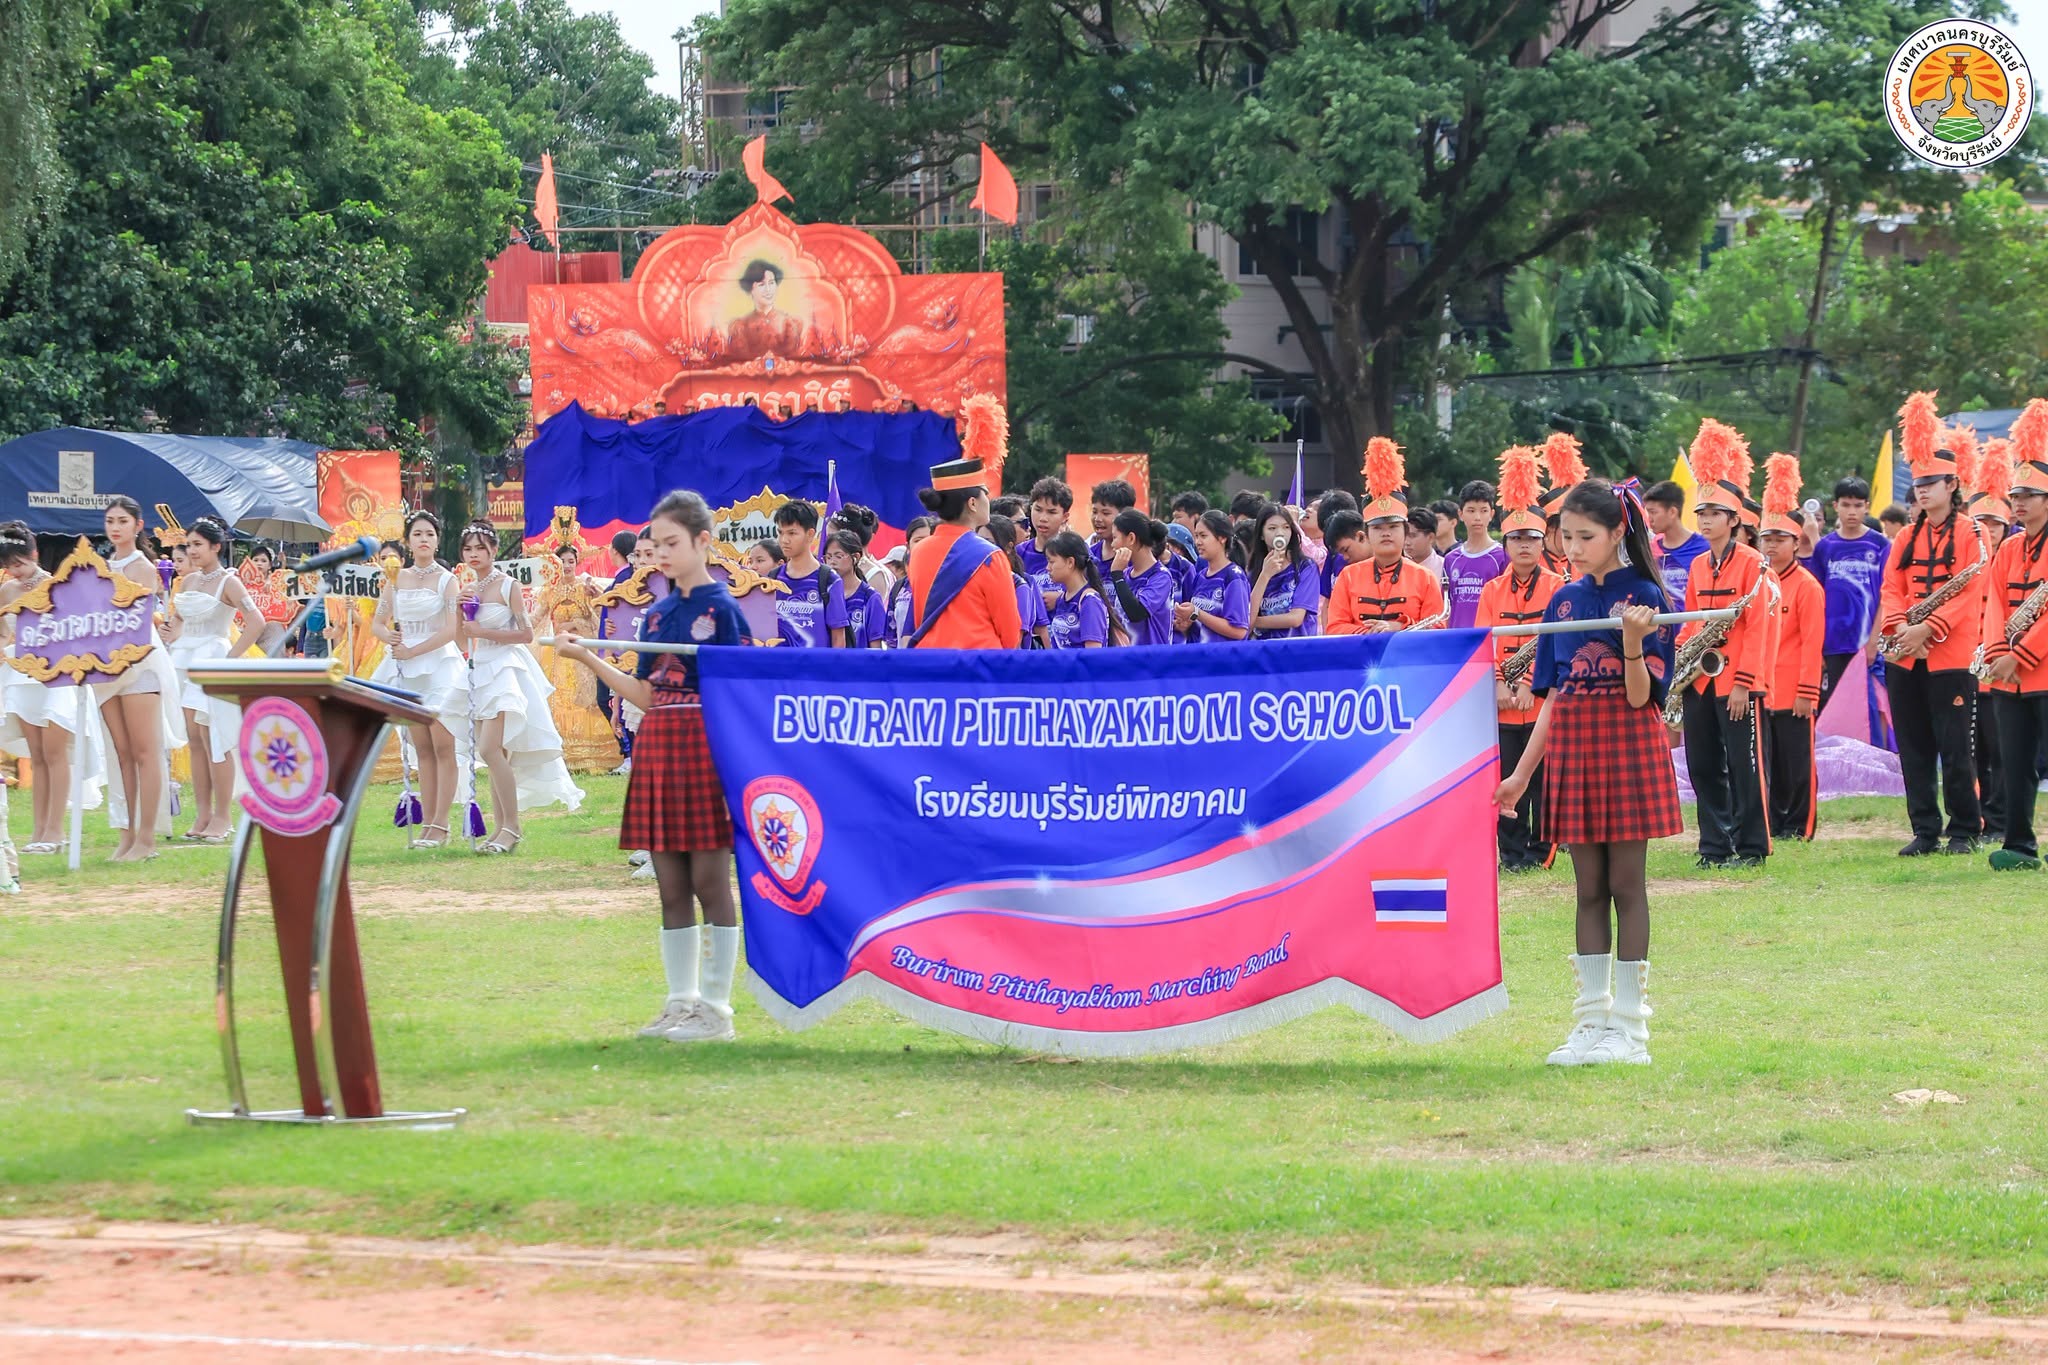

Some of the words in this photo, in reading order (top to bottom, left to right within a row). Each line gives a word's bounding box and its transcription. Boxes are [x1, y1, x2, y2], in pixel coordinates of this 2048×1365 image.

[29, 493, 111, 510] เทศบาลเมืองบุรีรั
[773, 695, 946, 747] BURIRAM
[951, 691, 1242, 748] PITTHAYAKHOM
[1249, 684, 1415, 742] SCHOOL
[913, 775, 1247, 831] โรงเรียนบุรีรัมย์พิทยาคม
[987, 973, 1142, 1013] Pitthayakhom
[1144, 964, 1242, 1006] Marching
[1242, 932, 1290, 977] Band
